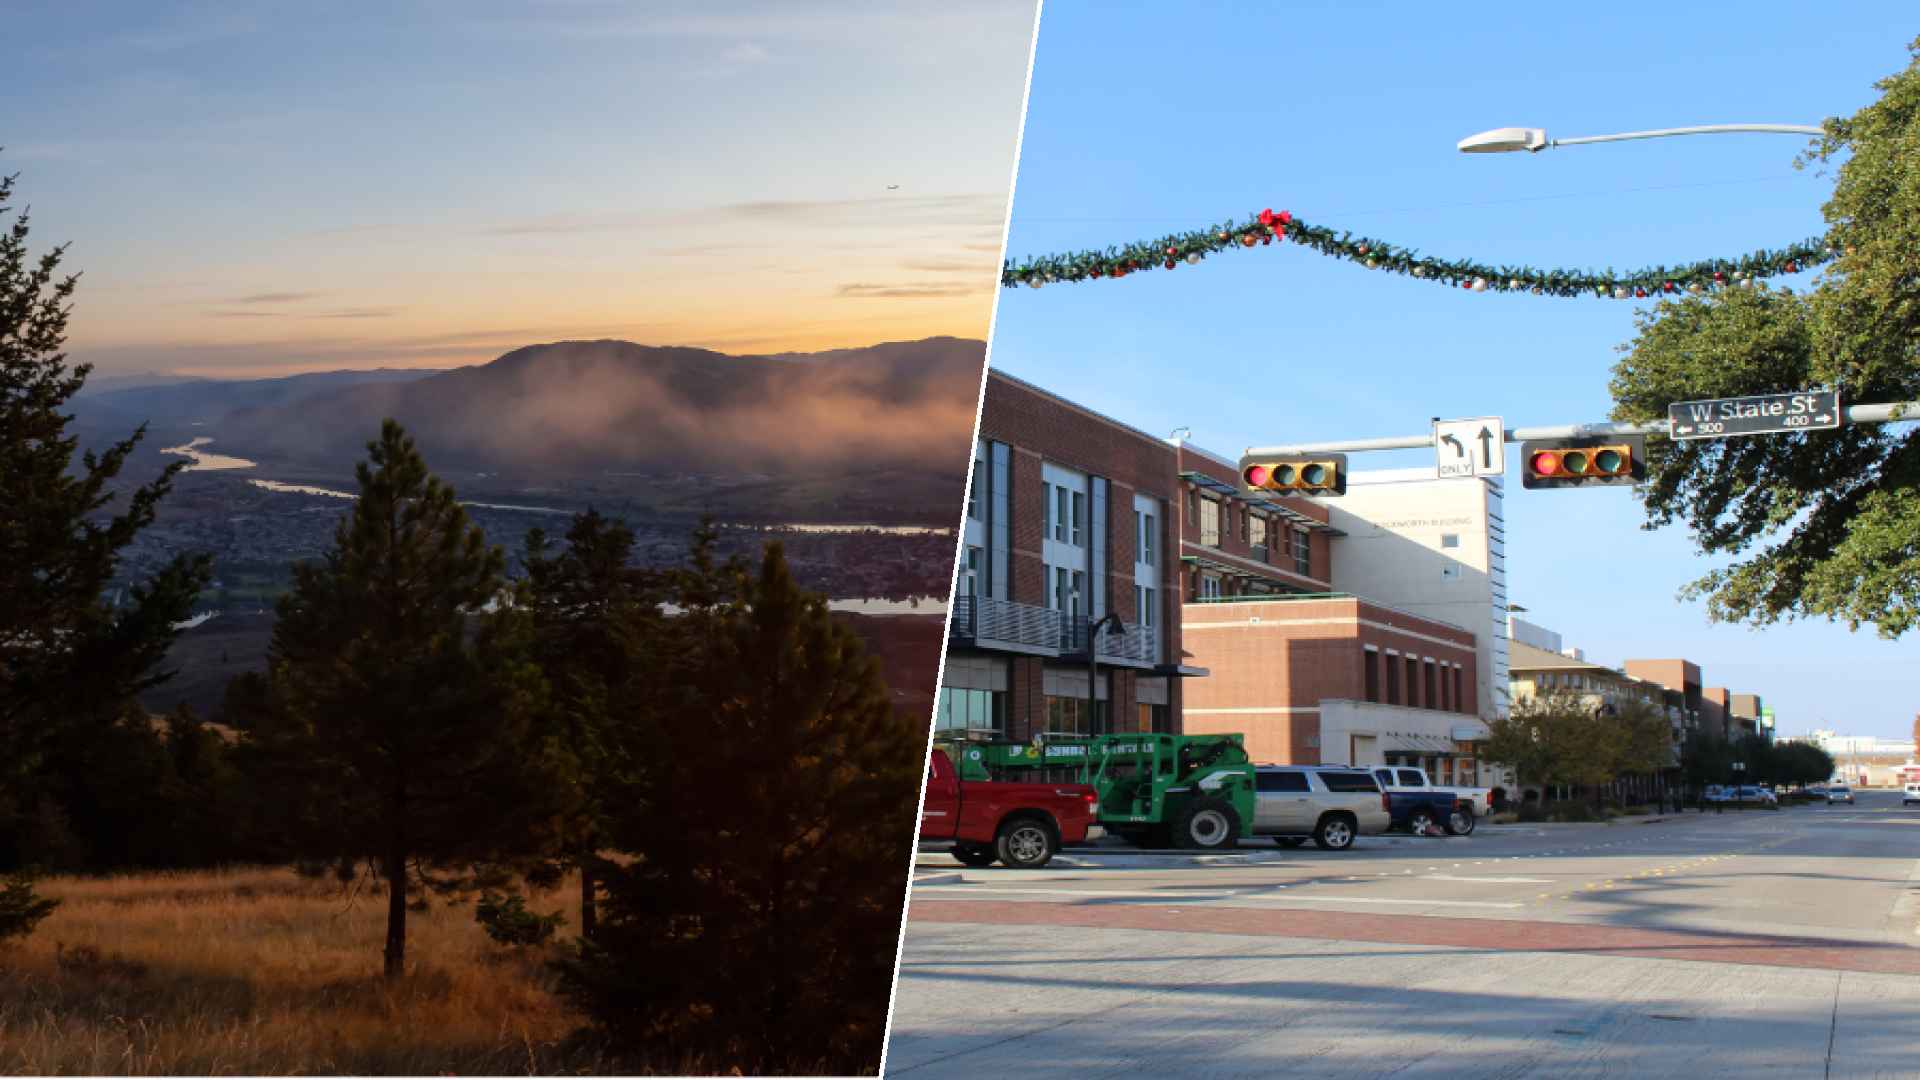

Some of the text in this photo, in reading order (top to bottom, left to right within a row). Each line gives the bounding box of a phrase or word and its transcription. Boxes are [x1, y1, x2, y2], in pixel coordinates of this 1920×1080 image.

[1690, 396, 1816, 422] W State St
[1783, 415, 1809, 426] 400
[1698, 422, 1724, 434] 500
[1440, 463, 1471, 474] ONLY
